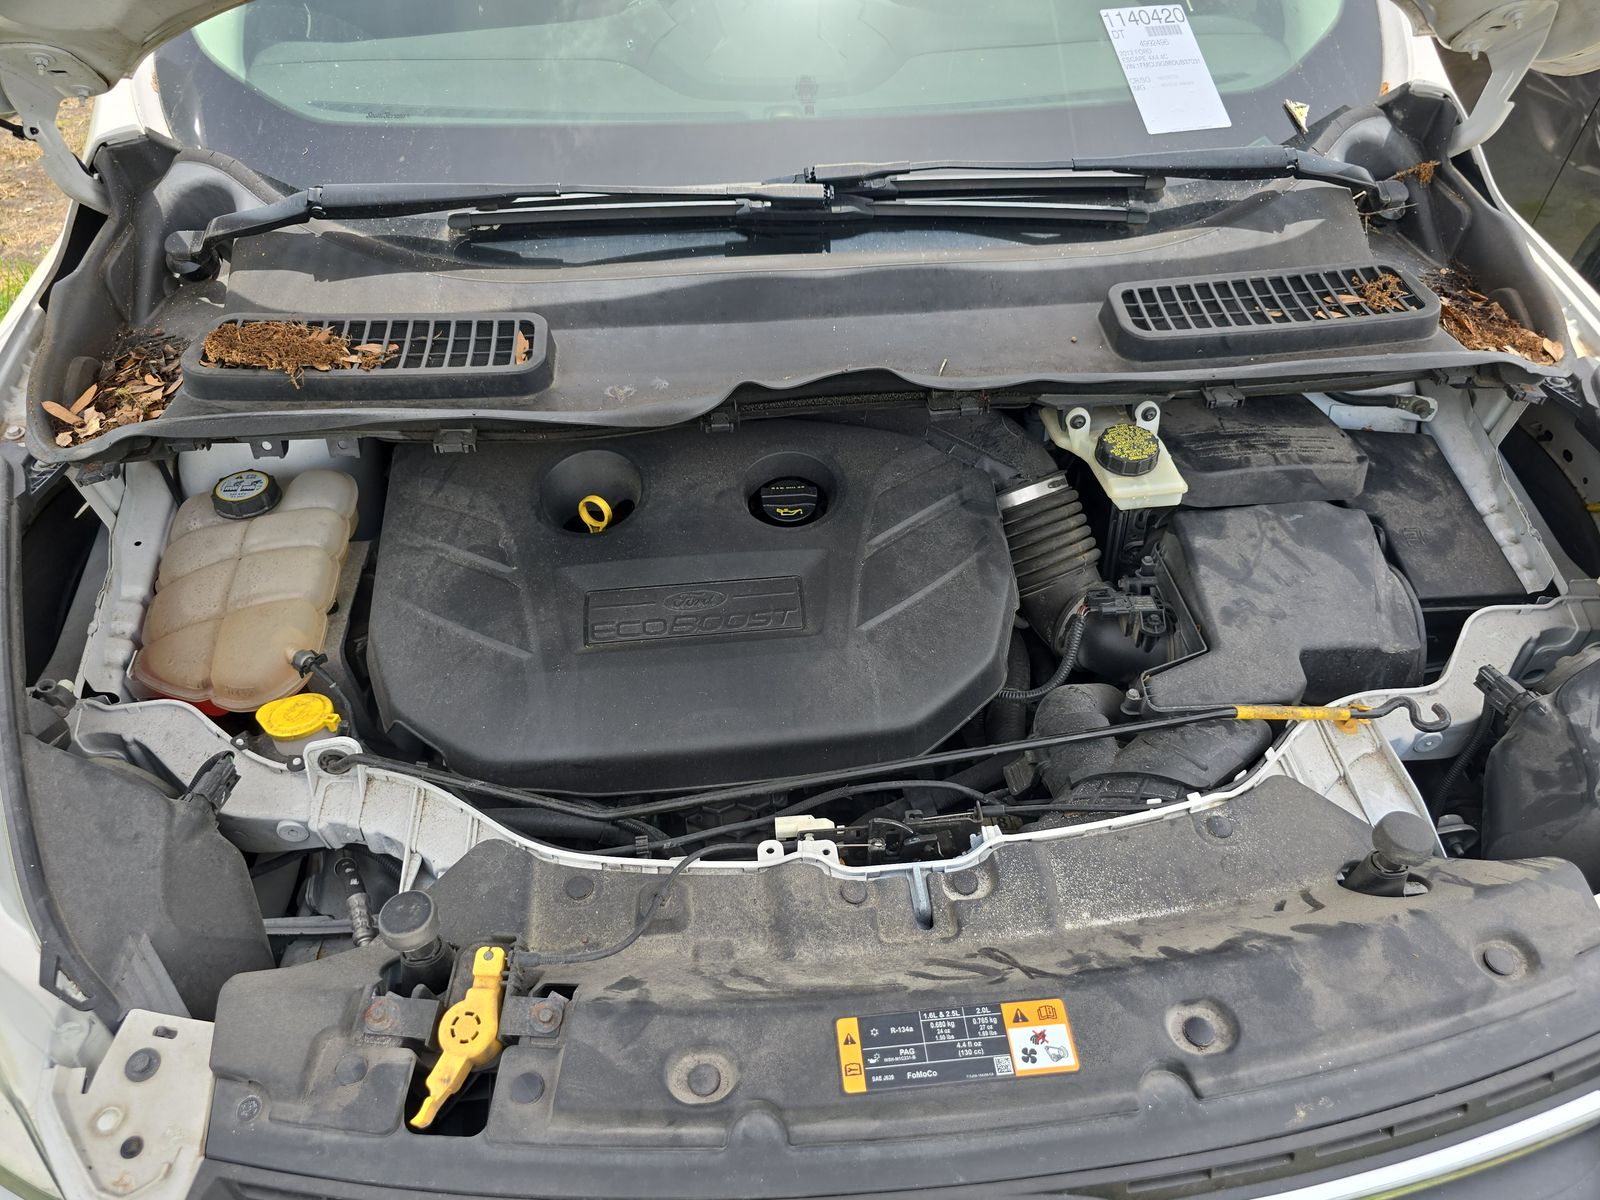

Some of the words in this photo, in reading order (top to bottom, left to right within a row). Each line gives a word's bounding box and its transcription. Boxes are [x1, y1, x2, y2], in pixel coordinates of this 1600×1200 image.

[1104, 8, 1185, 27] 1140420
[1111, 30, 1125, 39] DT
[1119, 49, 1134, 57] 2013
[671, 593, 717, 610] Ford
[591, 609, 800, 640] ECOBOOST
[924, 1012, 938, 1020] 1.6L
[946, 1010, 960, 1018] 2.5L
[947, 1020, 956, 1029] kg
[988, 1016, 998, 1024] kg
[907, 1070, 938, 1079] FoMoCo
